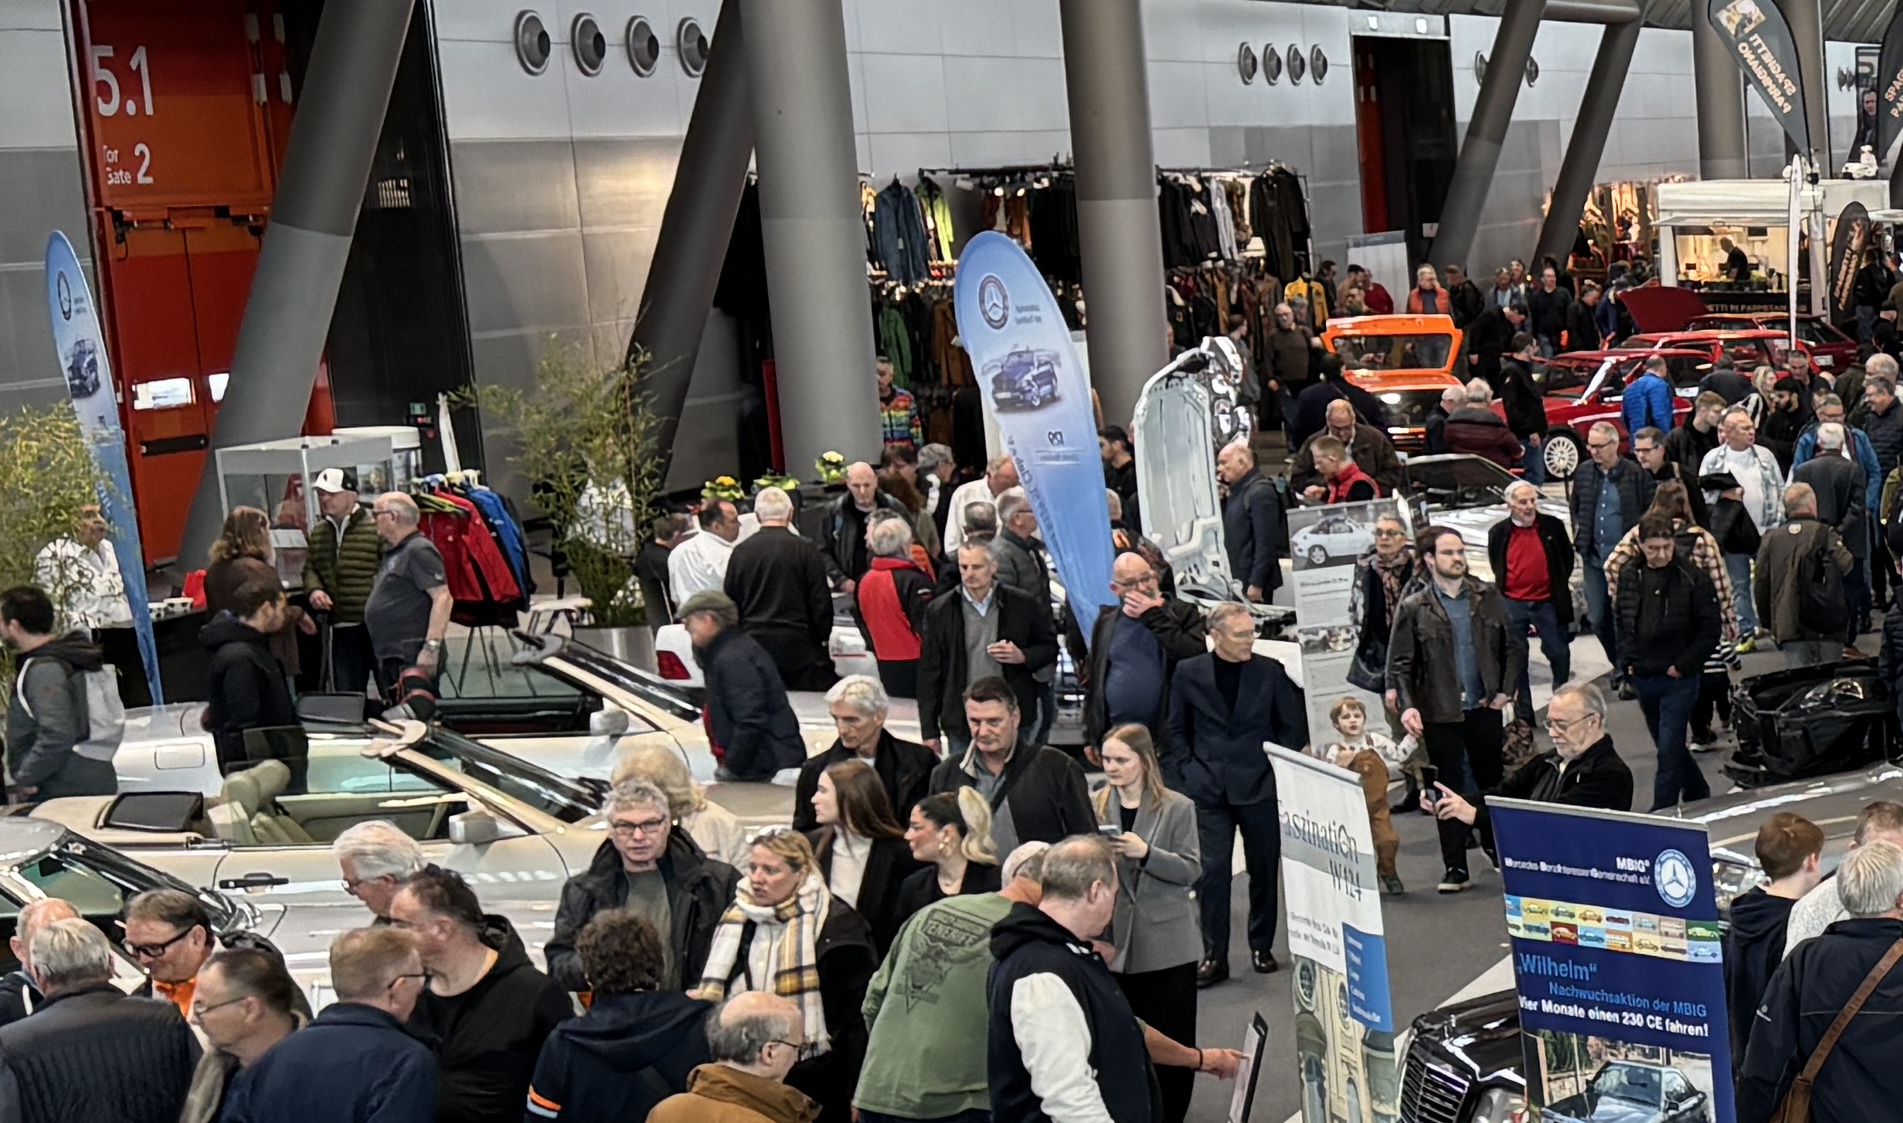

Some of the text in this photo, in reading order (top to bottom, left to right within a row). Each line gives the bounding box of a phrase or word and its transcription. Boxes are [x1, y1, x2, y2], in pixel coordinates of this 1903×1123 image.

[91, 45, 154, 116] 5.1
[103, 143, 153, 184] or 2
[1541, 999, 1585, 1018] Monate
[1588, 1006, 1621, 1024] einen
[1622, 1012, 1644, 1028] 230
[1646, 1014, 1664, 1031] CE
[1665, 1016, 1709, 1038] fahren!
[1549, 982, 1707, 1018] Nachwuchsaktion der MBIG
